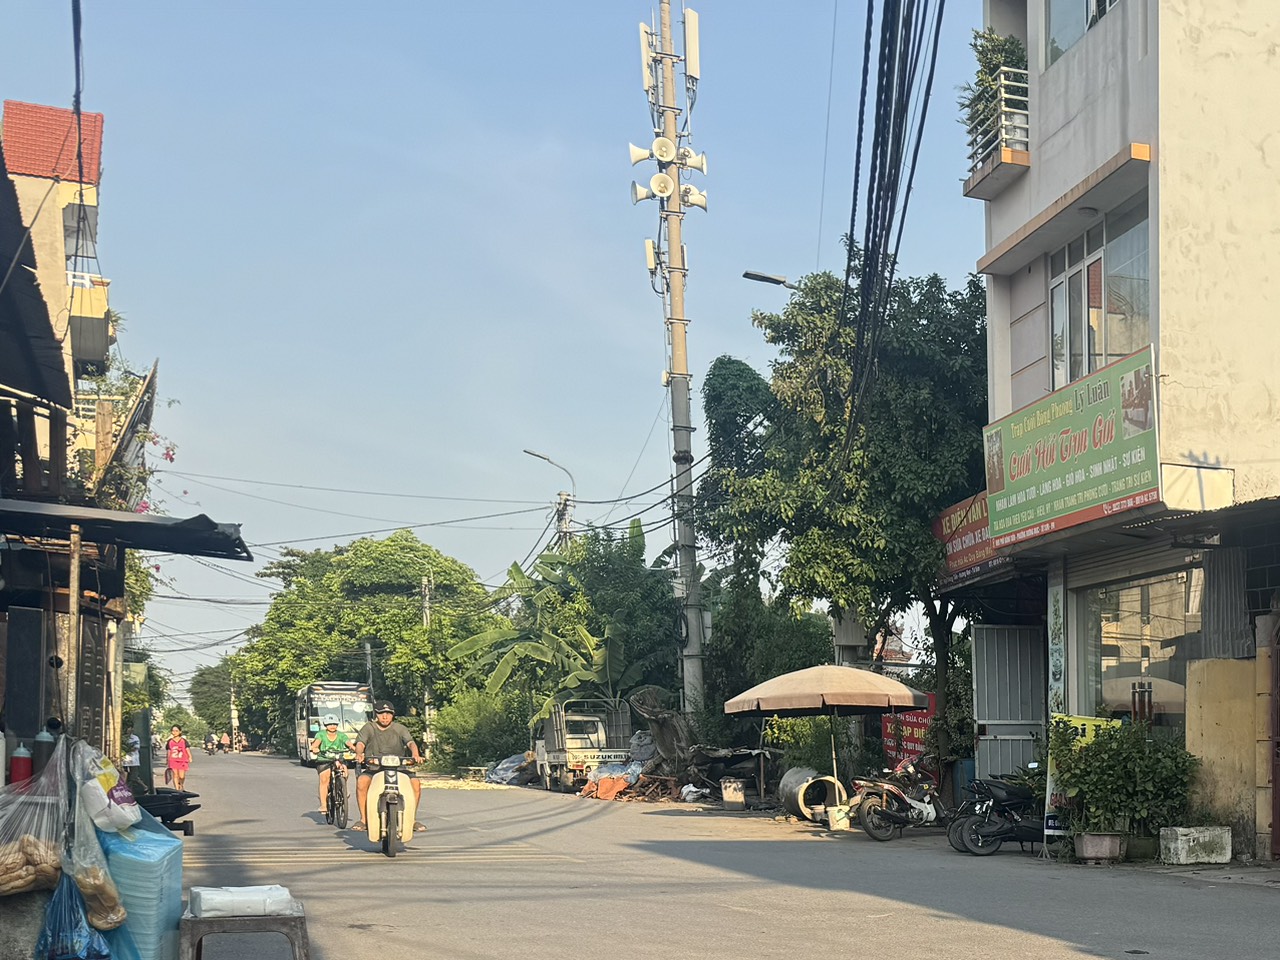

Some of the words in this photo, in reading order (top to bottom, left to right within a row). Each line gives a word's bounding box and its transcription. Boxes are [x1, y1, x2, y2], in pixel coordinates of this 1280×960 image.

[1087, 378, 1110, 406] Luận
[1009, 443, 1032, 482] Cưới
[1035, 433, 1057, 473] Hỏi
[1059, 426, 1088, 463] Trọn
[1092, 407, 1116, 450] Gói
[1122, 450, 1131, 469] SỰ
[1131, 445, 1146, 465] KIỆN
[942, 516, 950, 535] XE
[951, 508, 967, 532] ĐIỆN
[953, 535, 962, 552] SỬA
[975, 529, 982, 543] XE
[981, 526, 990, 542] ĐẠ
